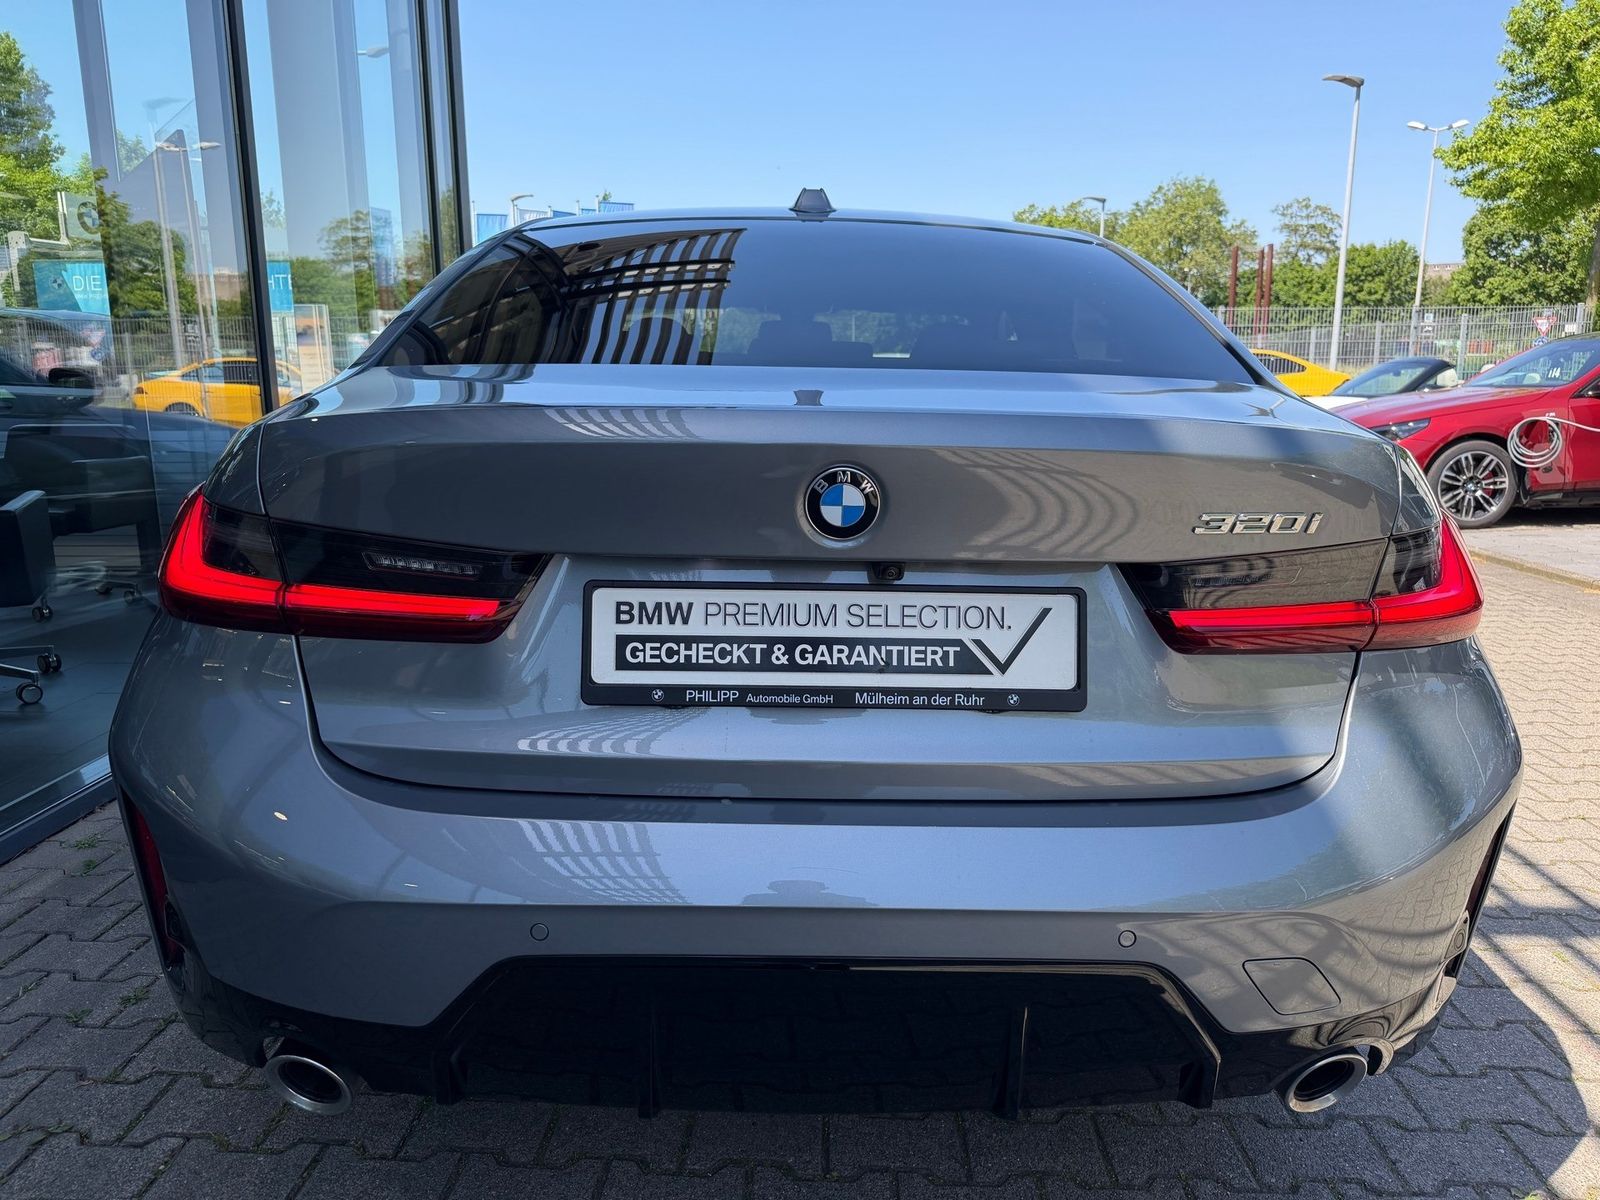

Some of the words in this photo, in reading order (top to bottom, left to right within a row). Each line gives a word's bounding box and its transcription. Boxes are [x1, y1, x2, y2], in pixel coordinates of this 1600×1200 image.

[72, 275, 103, 291] DIE
[813, 470, 875, 495] BMW
[1191, 512, 1324, 535] 320i
[615, 601, 694, 625] BMW
[704, 602, 838, 627] PREMIUM
[847, 603, 1012, 630] SELECTION.
[625, 642, 768, 664] GECHECKT
[771, 643, 789, 665] &
[794, 643, 961, 667] GARANTIERT
[685, 689, 740, 702] PHILIPP
[746, 693, 801, 703] Automobile
[802, 694, 834, 704] GmbH
[855, 691, 909, 705] Mülheim
[912, 695, 928, 705] an
[930, 693, 952, 706] der
[954, 693, 985, 706] Ruhr
